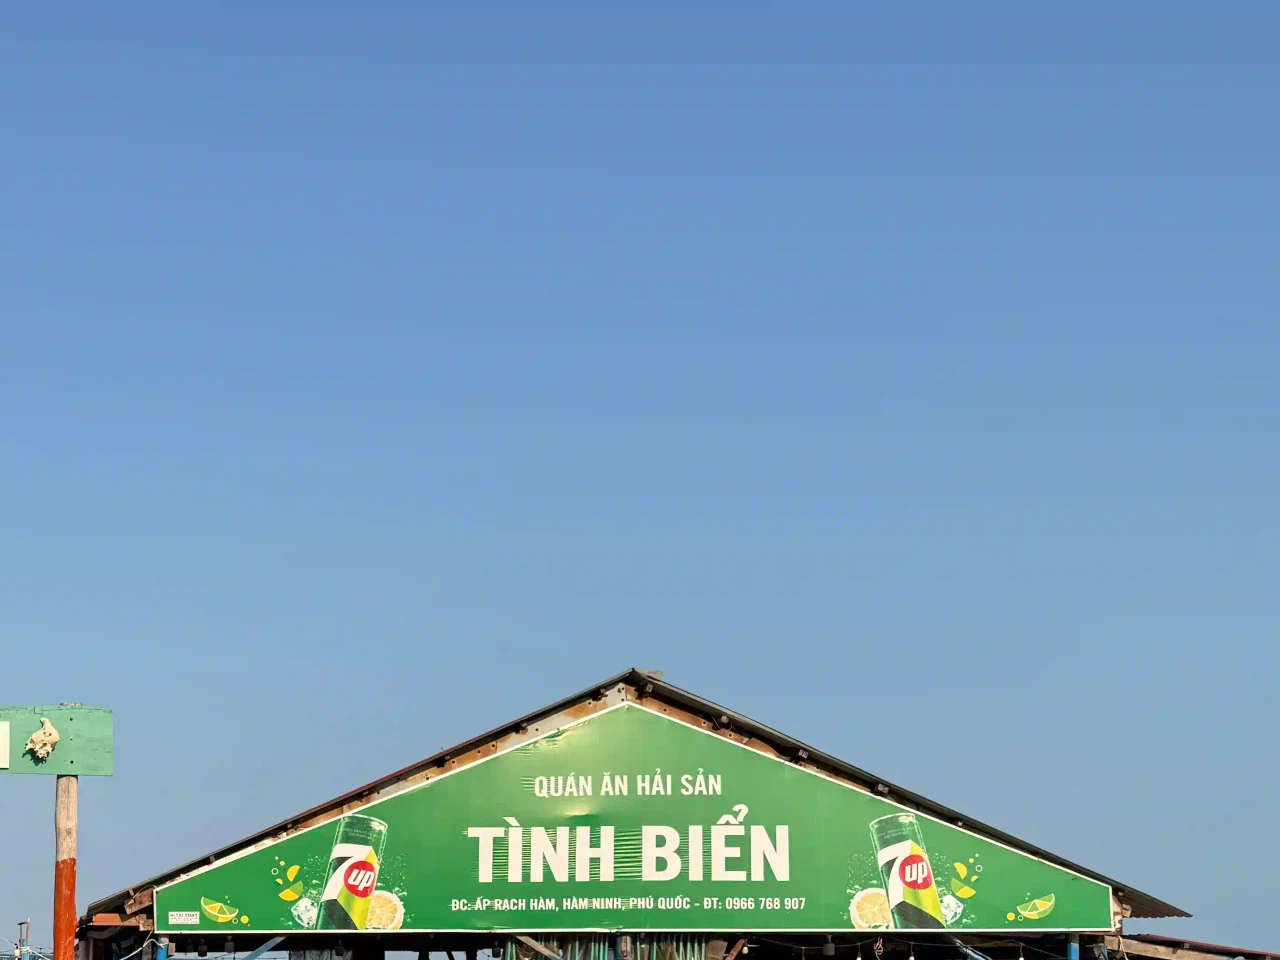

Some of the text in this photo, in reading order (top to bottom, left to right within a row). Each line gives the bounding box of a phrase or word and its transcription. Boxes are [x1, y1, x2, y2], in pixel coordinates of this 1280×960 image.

[534, 768, 722, 798] QUÁN ĂN HẢI SẢN
[467, 803, 790, 883] TÌNH BIỂN
[475, 896, 491, 911] ẤP
[529, 896, 559, 912] HÀM,
[562, 896, 588, 910] HÀM
[592, 897, 625, 911] NINH,
[629, 895, 654, 910] PHÚ
[657, 894, 691, 910] QUỐC
[703, 897, 723, 910] ĐT:
[725, 897, 755, 910] 0966
[759, 897, 781, 910] 768
[784, 897, 806, 910] 907
